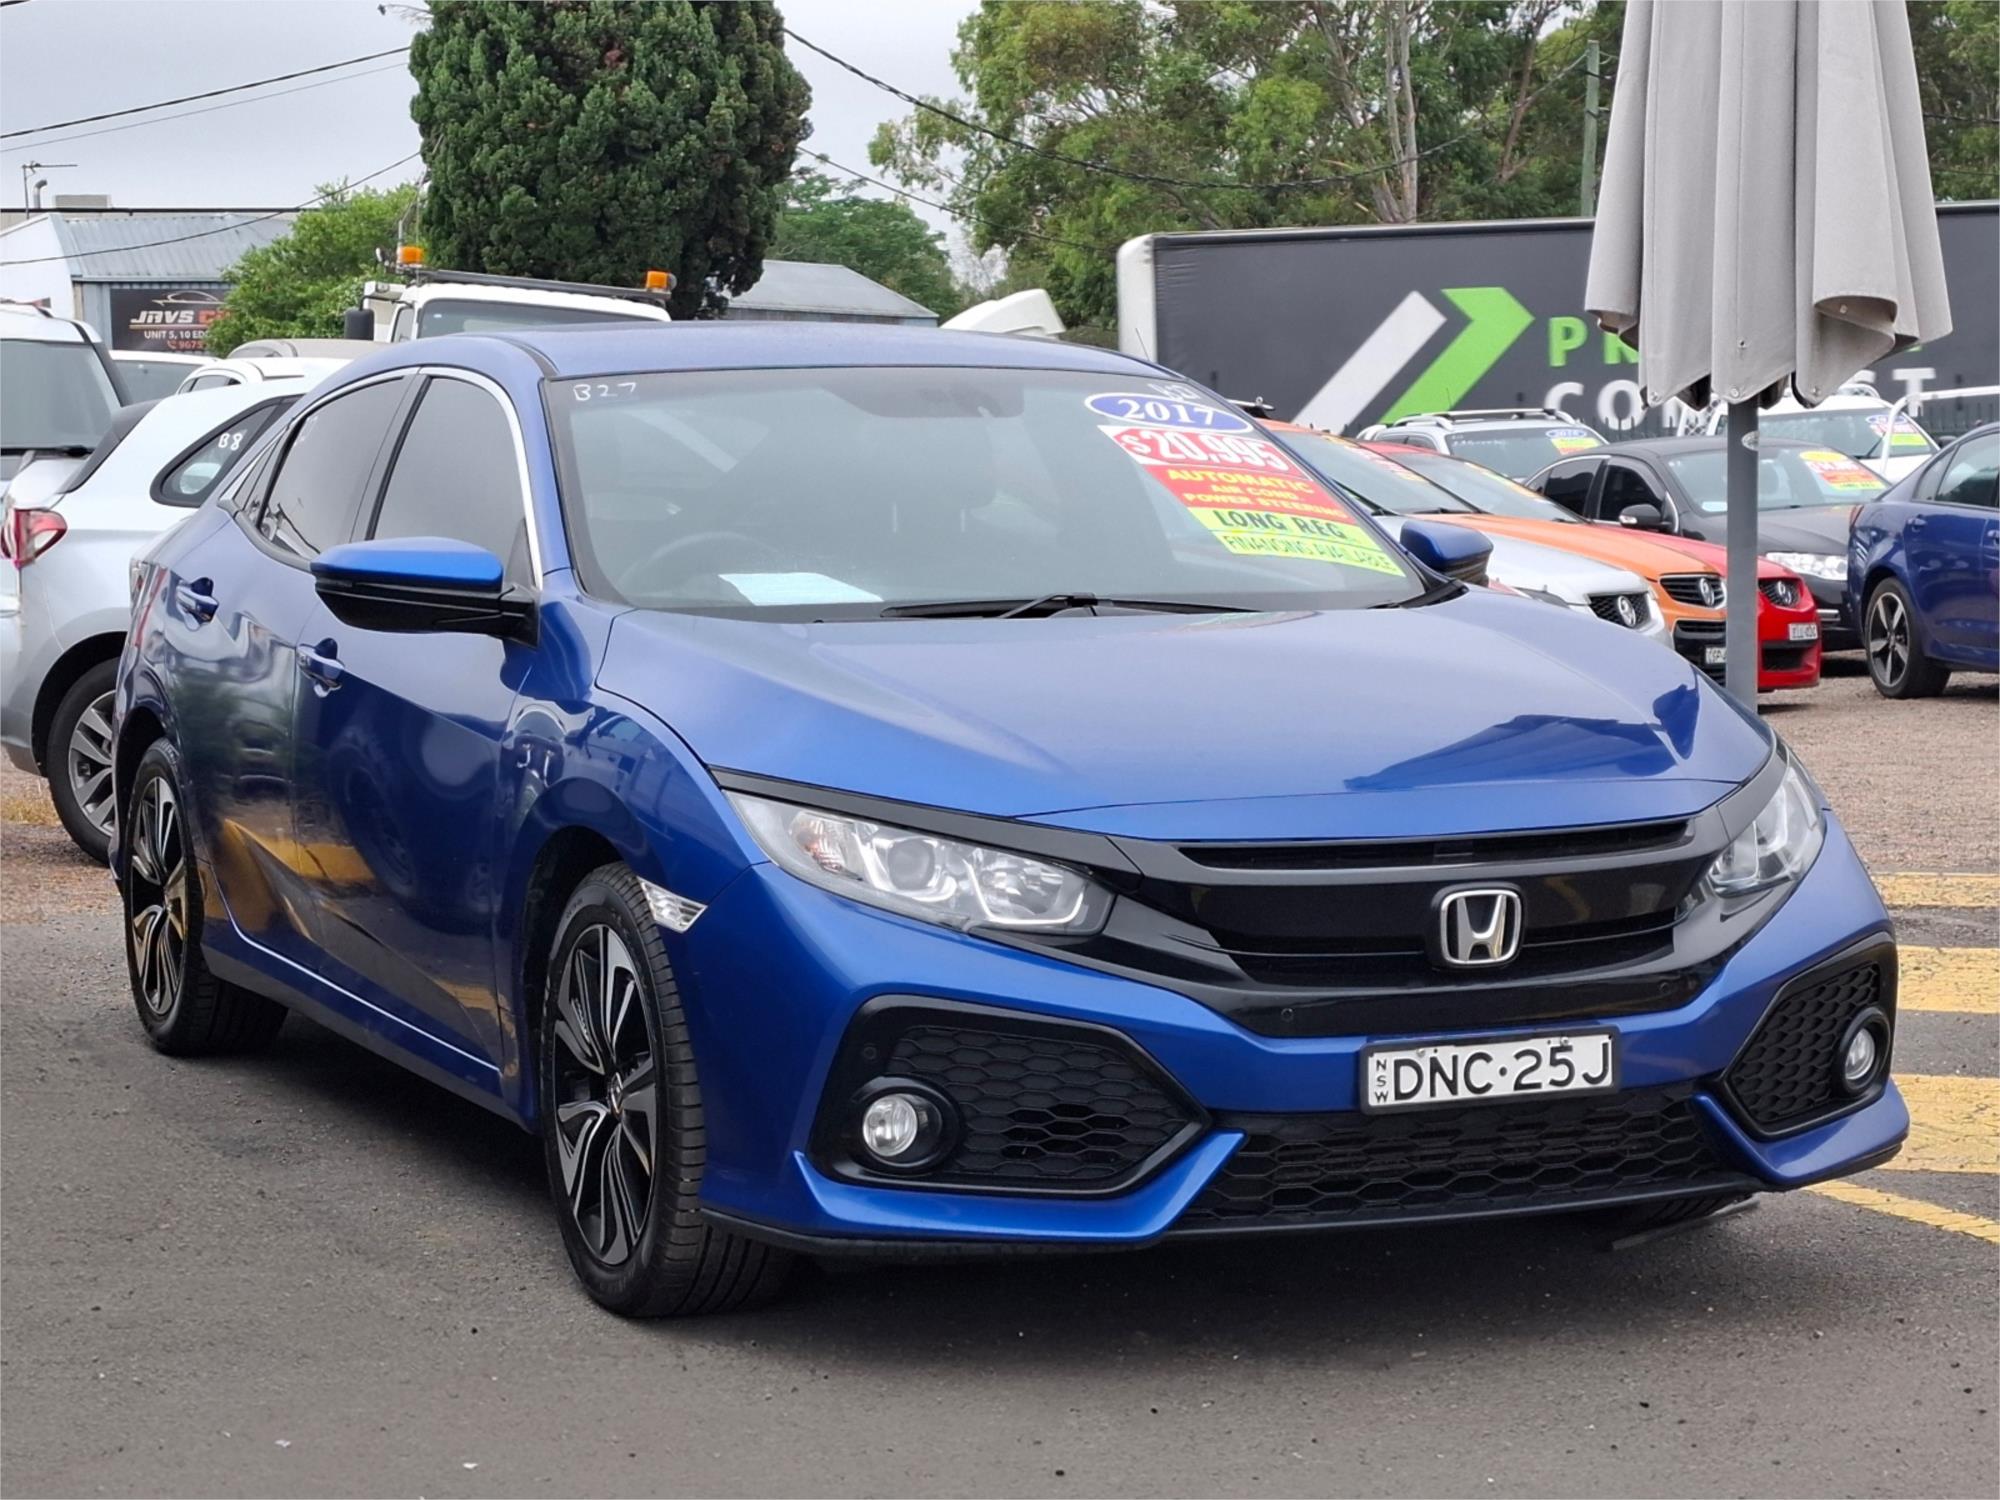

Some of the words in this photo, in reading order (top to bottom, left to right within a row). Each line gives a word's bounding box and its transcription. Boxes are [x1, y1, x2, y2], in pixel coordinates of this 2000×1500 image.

[144, 331, 166, 339] UNIT
[573, 382, 637, 401] B27
[1117, 399, 1216, 425] 2017
[1167, 468, 1315, 494] AUTOMATIC
[1211, 484, 1244, 494] AIR
[1183, 493, 1253, 505] POWER
[1255, 498, 1348, 519] STEERING
[1213, 510, 1287, 531] LONG
[1292, 517, 1347, 540] REG
[1375, 1059, 1388, 1103] NSW
